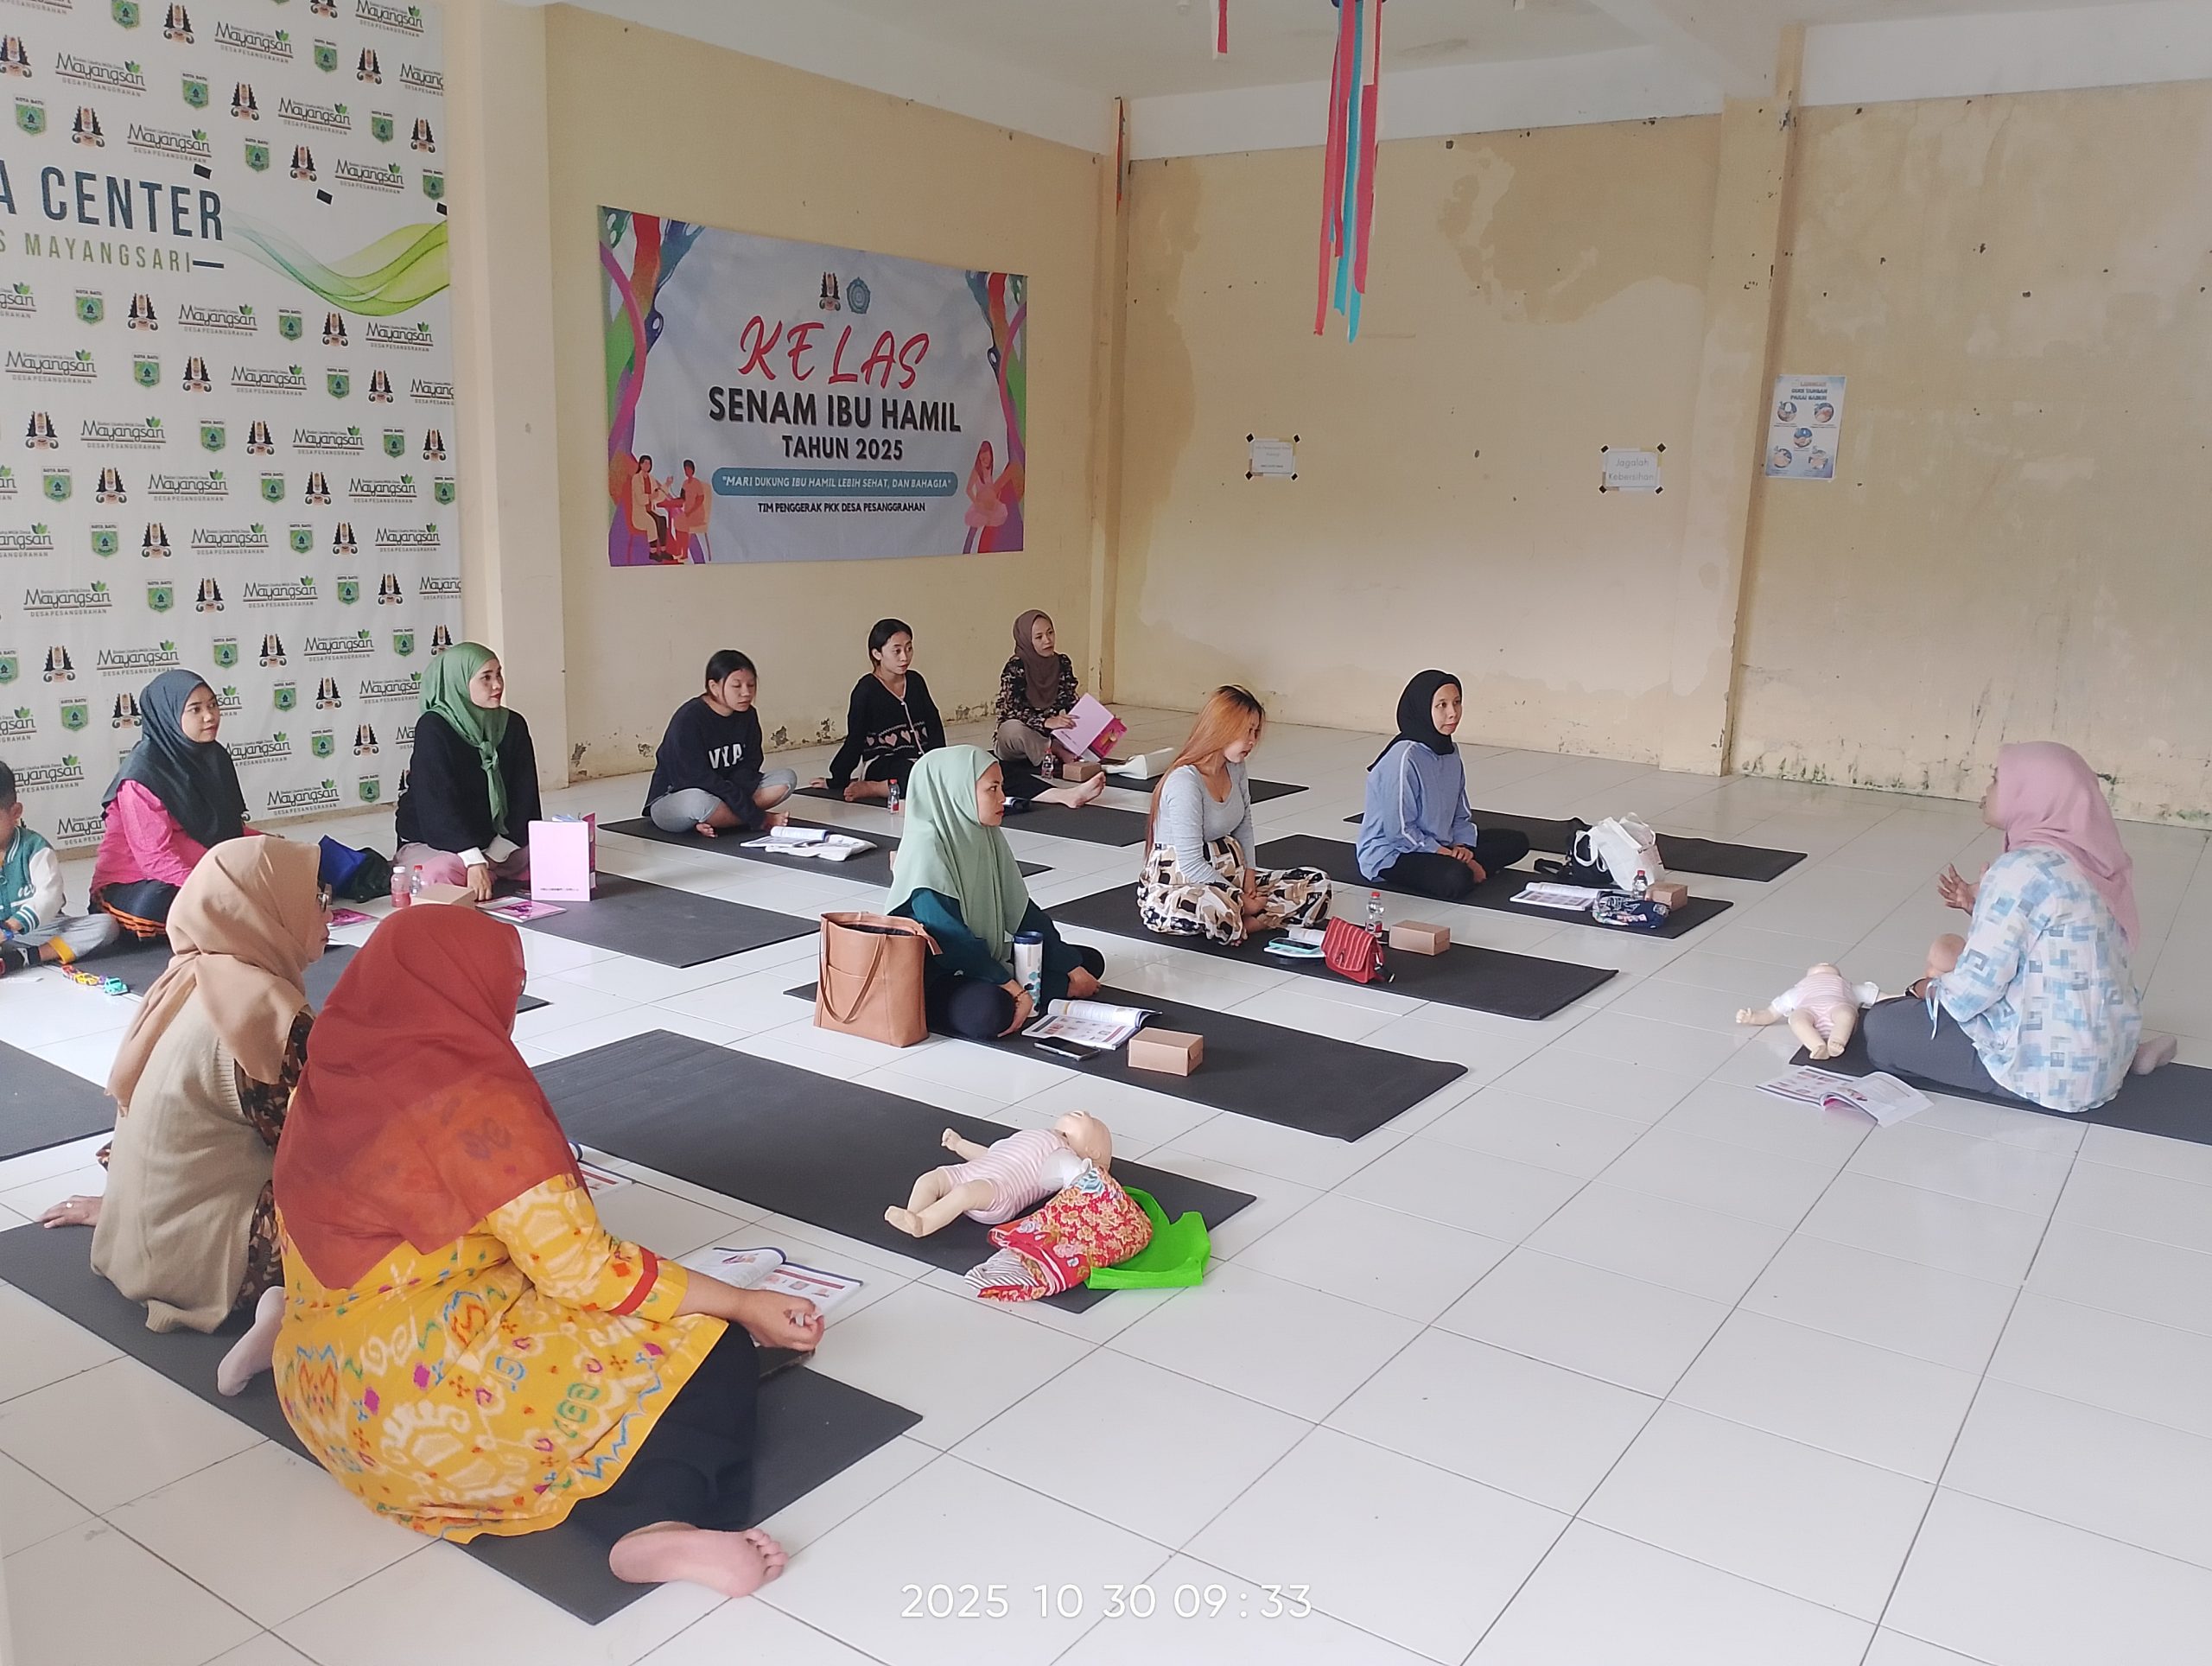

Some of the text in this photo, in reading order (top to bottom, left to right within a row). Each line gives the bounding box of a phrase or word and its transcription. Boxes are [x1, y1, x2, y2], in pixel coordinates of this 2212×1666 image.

[41, 166, 223, 241] CENTER
[24, 232, 190, 273] MAYANGSARI
[738, 315, 930, 390] KELAS
[709, 386, 962, 432] SENAM IBU HAMIL
[782, 436, 903, 461] TAHUN 2025
[754, 477, 790, 486] DUKUNG
[791, 477, 807, 486] IBU
[809, 477, 836, 487] HAMIL
[837, 478, 861, 487] LEBIH
[892, 479, 909, 488] DAN
[758, 502, 926, 512] TIM PENGGERAK PKK DESA PESANGGRAHAN
